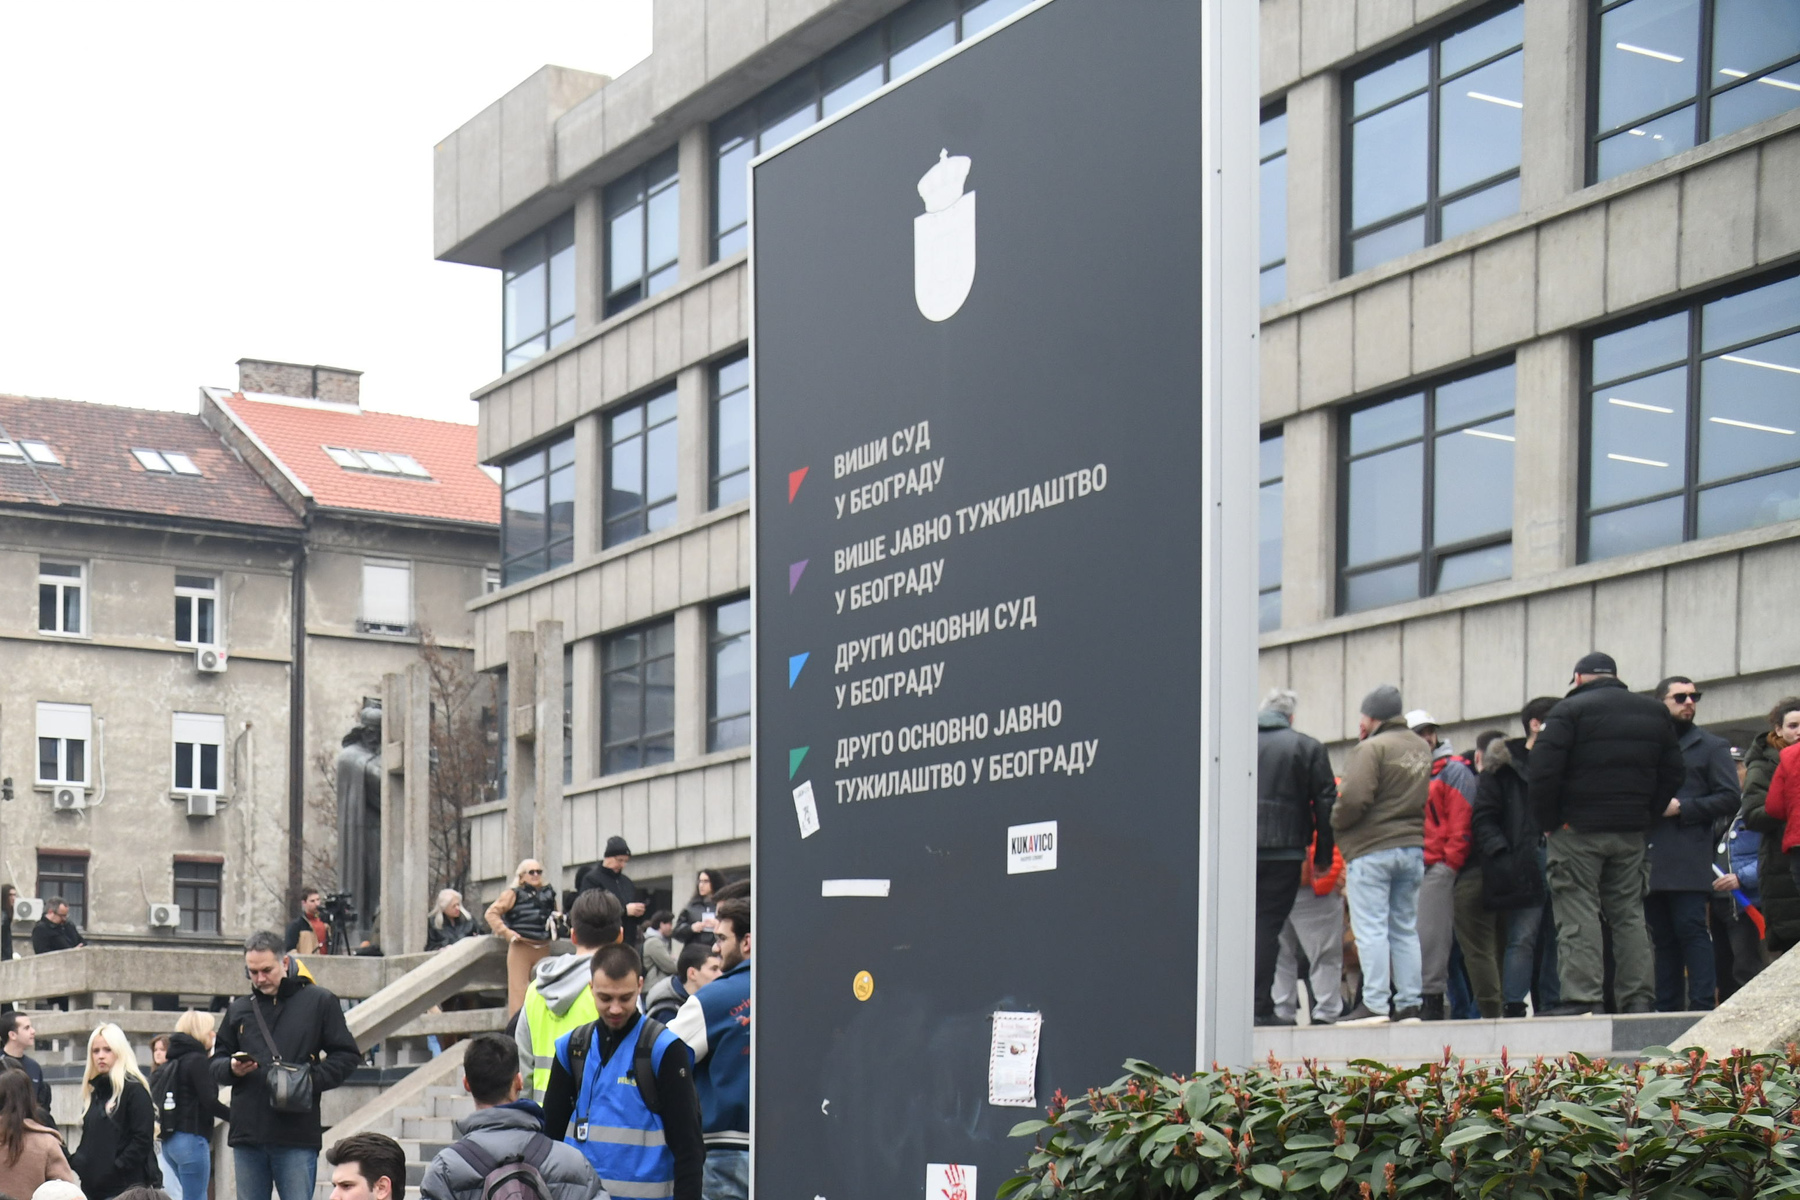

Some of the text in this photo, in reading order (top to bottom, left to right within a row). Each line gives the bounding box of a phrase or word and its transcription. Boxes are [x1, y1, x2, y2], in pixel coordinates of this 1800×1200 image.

[834, 421, 930, 479] ВИШИ СУД
[835, 457, 944, 519] У БЕОГРАДУ
[835, 464, 1107, 574] ВИШЕ ЈАВНО ТУЖИЛАШТВО
[835, 559, 944, 614] У БЕОГРАДУ
[835, 596, 1037, 674] ДРУГИ ОСНОВНИ СУД
[835, 662, 944, 709] У БЕОГРАДУ
[835, 699, 1062, 768] ДРУГО ОСНОВНО ЈАВНО
[835, 739, 1098, 803] ТУЖИЛАШТВО У БЕОГРАДУ
[1011, 832, 1053, 855] KUKAVICO
